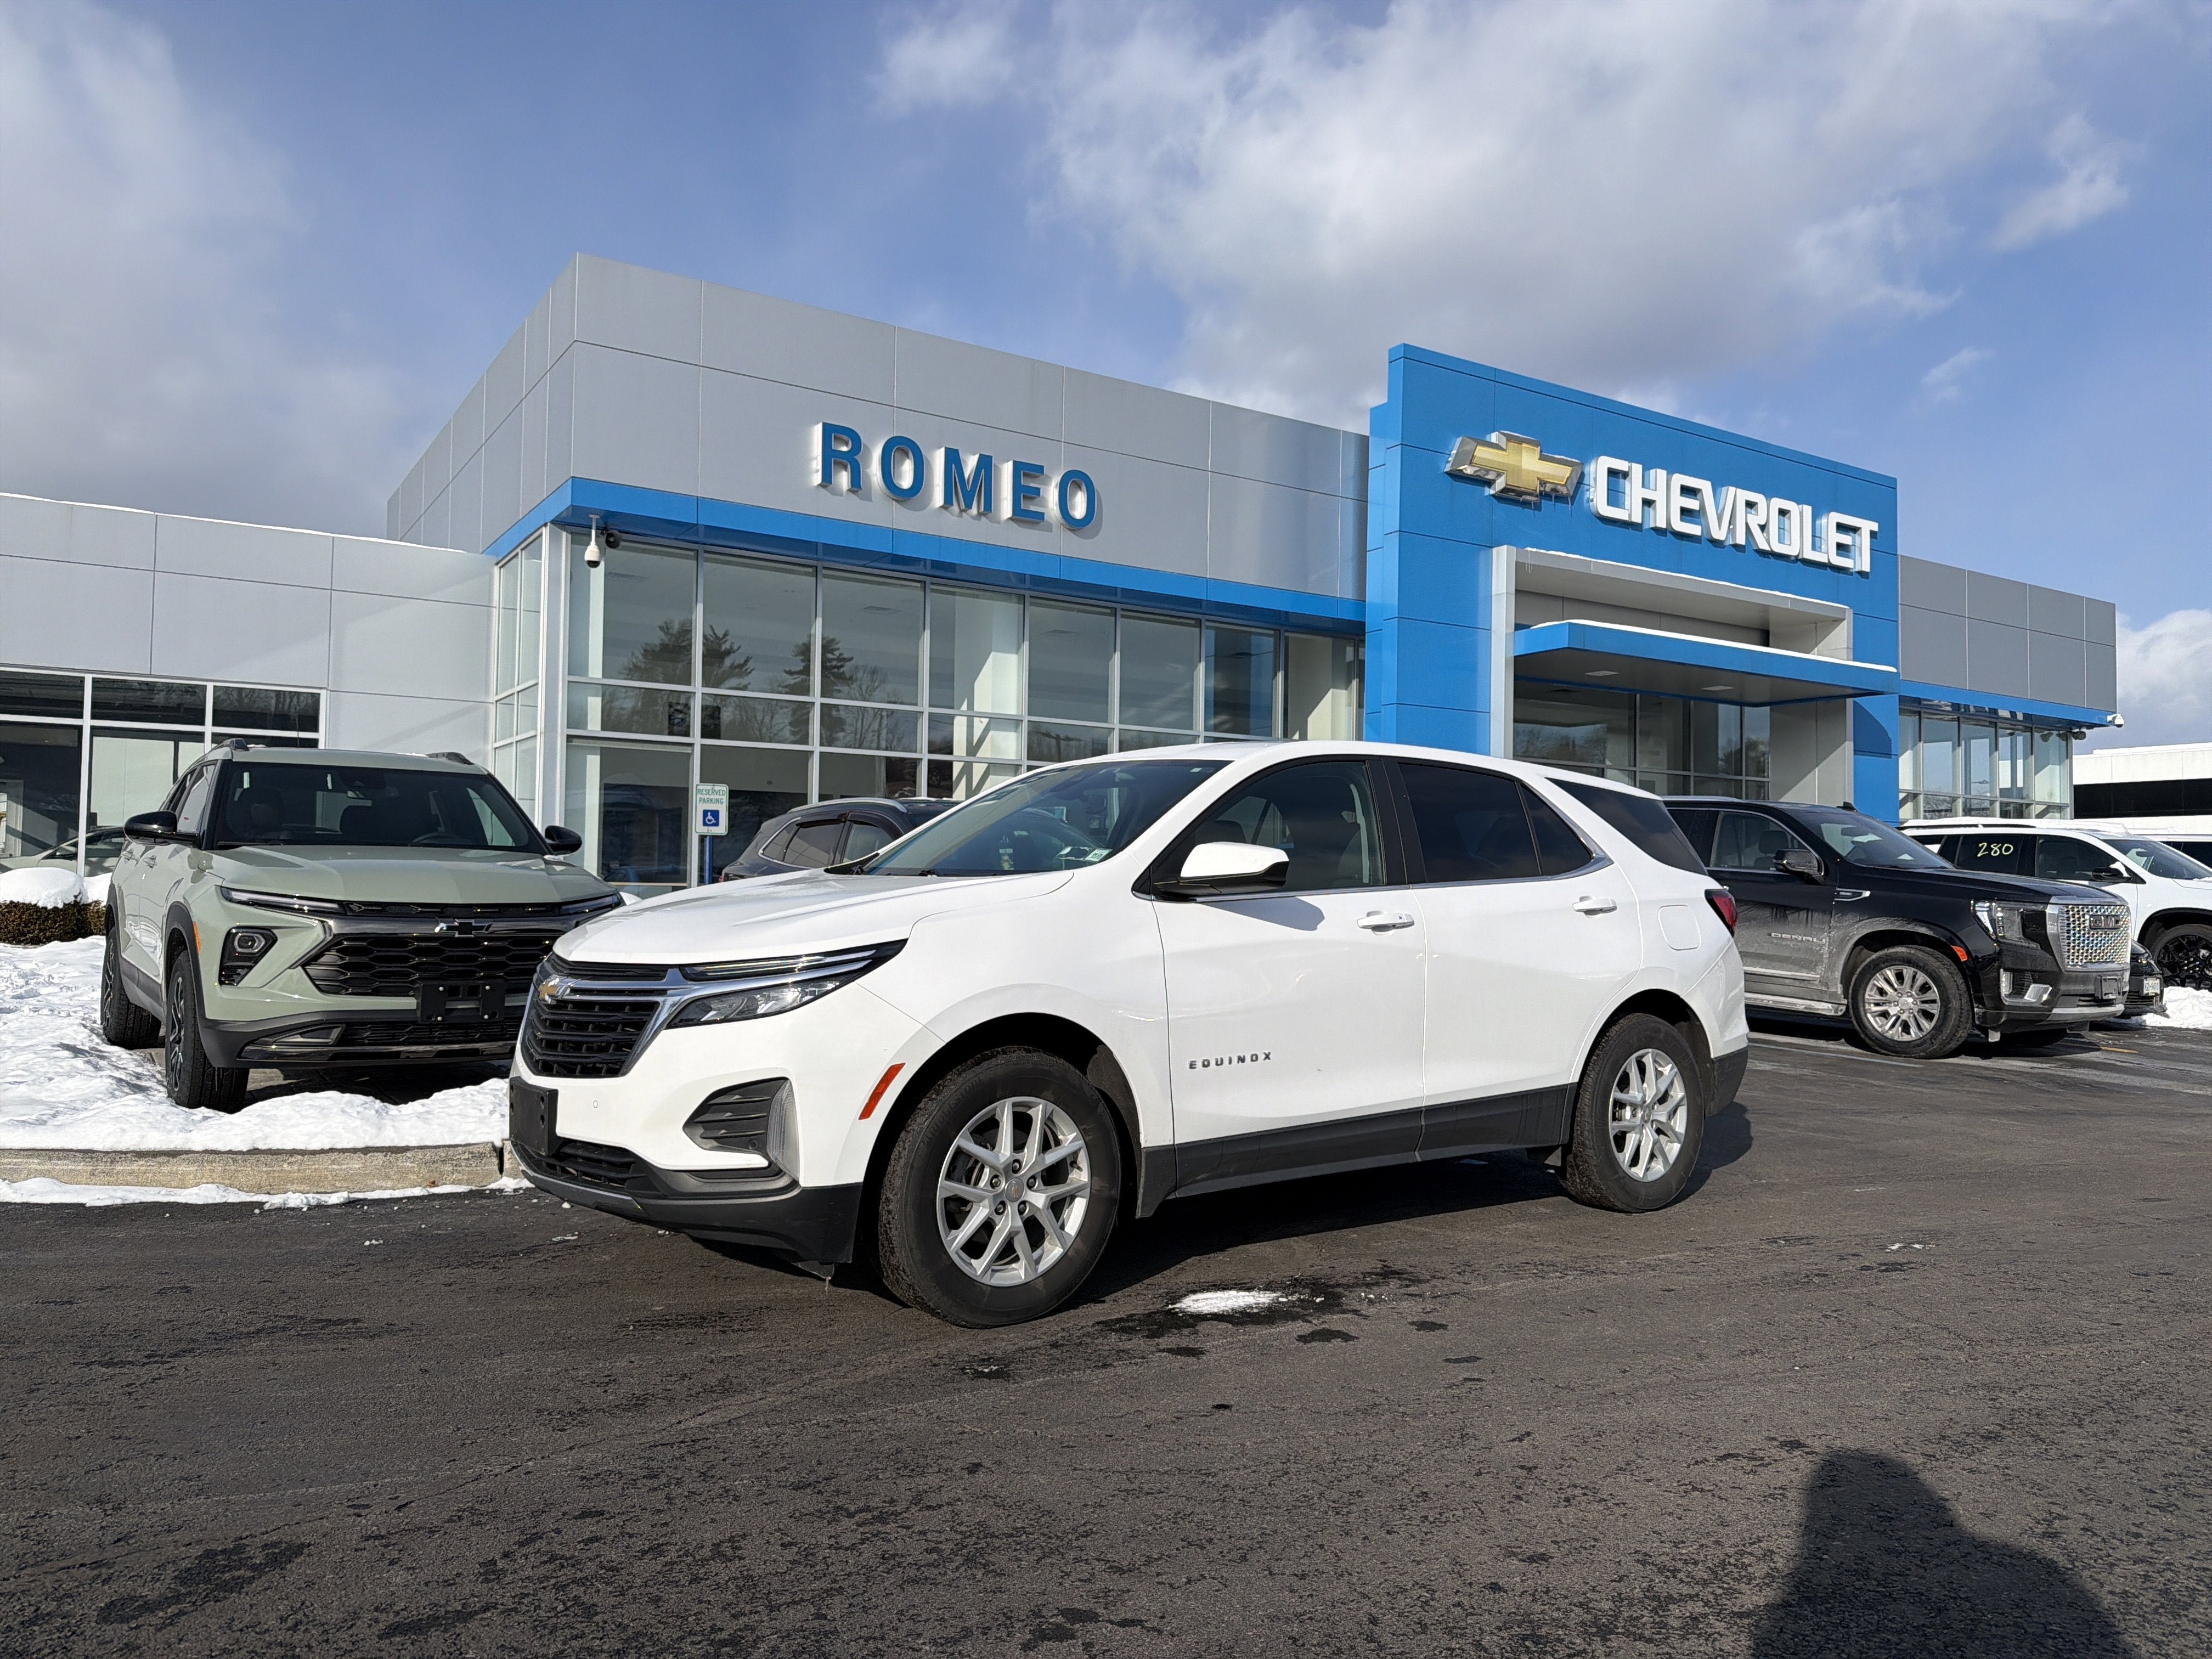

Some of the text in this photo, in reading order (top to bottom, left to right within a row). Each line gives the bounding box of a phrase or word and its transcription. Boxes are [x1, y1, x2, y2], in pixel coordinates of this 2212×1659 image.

[817, 421, 1096, 529] ROMEO
[1591, 455, 1879, 573] CHEVROLET
[1977, 842, 2014, 857] 280
[2091, 915, 2121, 928] GMC
[1188, 1051, 1272, 1070] EQUINOX
